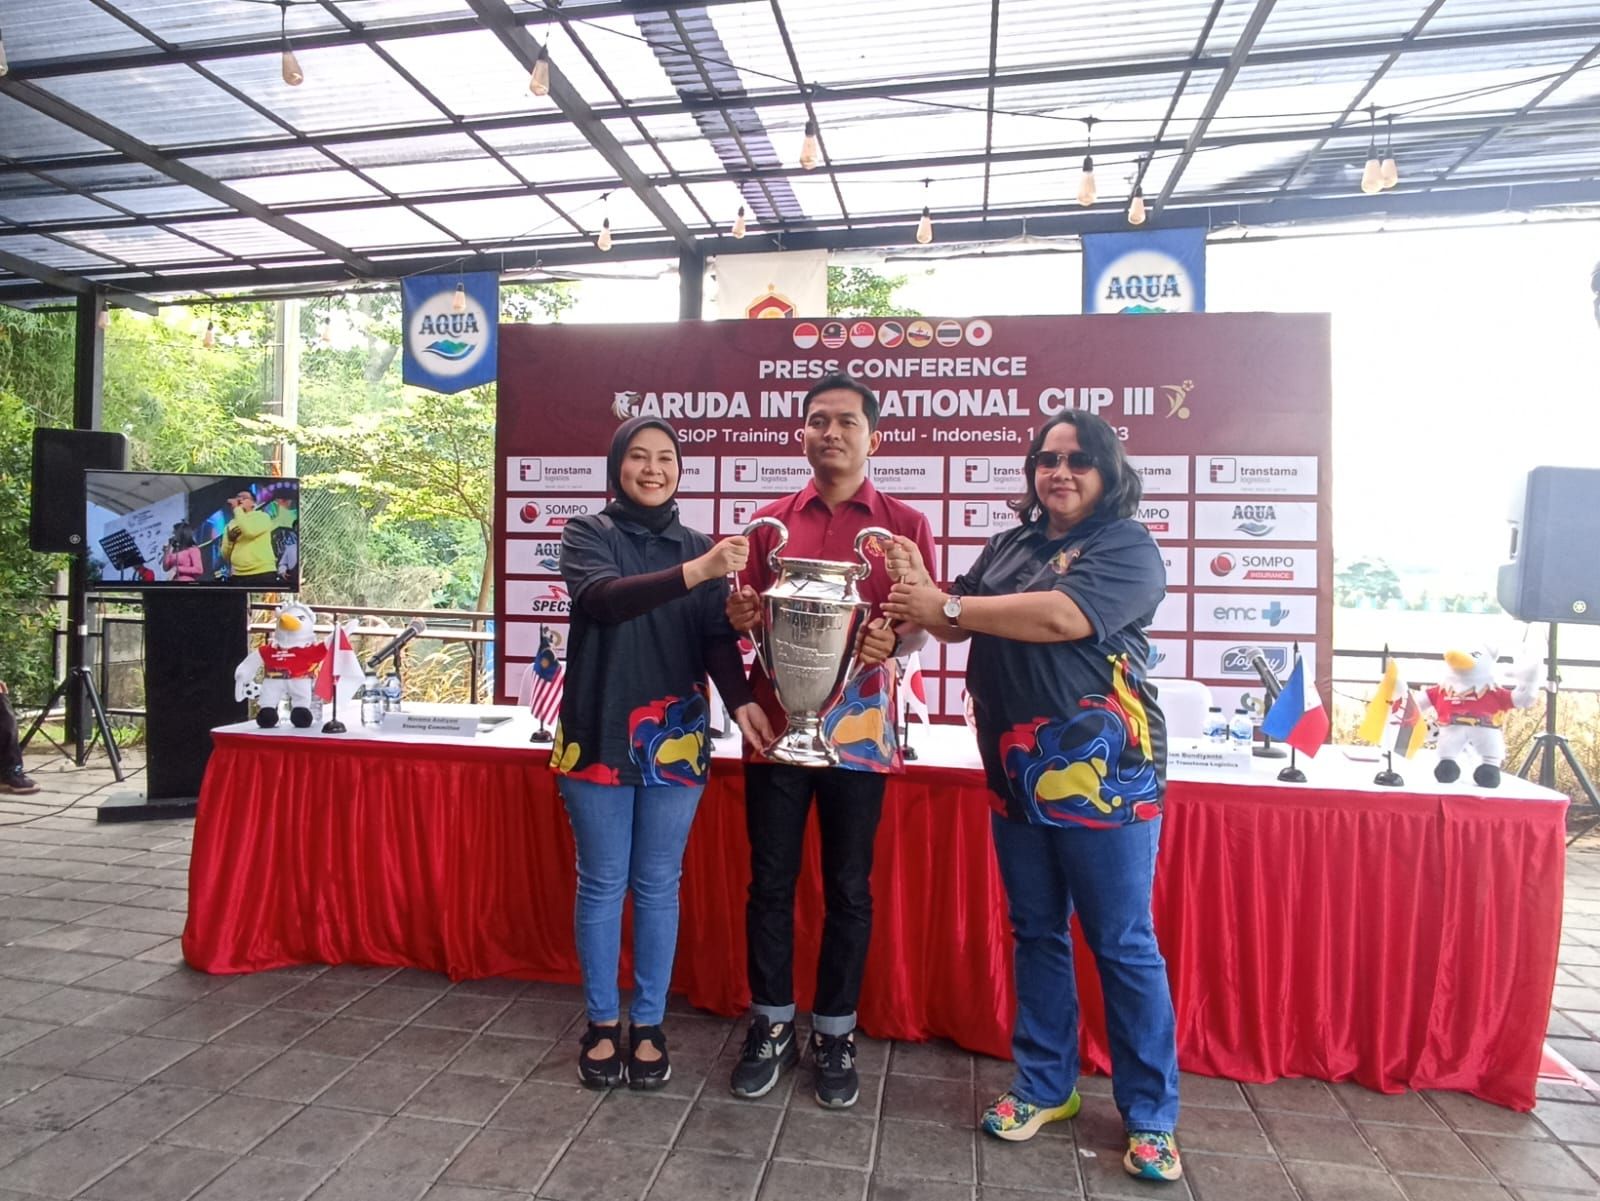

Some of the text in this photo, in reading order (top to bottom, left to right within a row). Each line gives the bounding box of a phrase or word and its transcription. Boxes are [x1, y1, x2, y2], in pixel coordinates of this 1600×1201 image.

[1105, 274, 1181, 303] AQUA
[418, 312, 479, 338] AQUA
[759, 356, 1027, 379] PRESS CONFERENCE
[760, 388, 1029, 418] INTATIONAL
[1038, 387, 1114, 416] CUP
[1123, 387, 1155, 415] III
[678, 428, 717, 443] SIOP
[722, 428, 788, 445] Training
[932, 427, 1022, 444] Indonesia,
[544, 466, 592, 475] transtama
[761, 466, 812, 476] transtama
[873, 466, 926, 476] transtama
[993, 467, 1025, 476] transt
[1240, 466, 1298, 476] transtama
[545, 504, 588, 515] SOMPO
[1138, 508, 1170, 519] MPO
[1232, 505, 1276, 522] AQUA
[534, 542, 561, 558] AQU
[1242, 556, 1294, 568] SOMPO
[532, 600, 573, 612] SPECS
[1213, 606, 1257, 621] emc
[1225, 654, 1280, 671] Joyy
